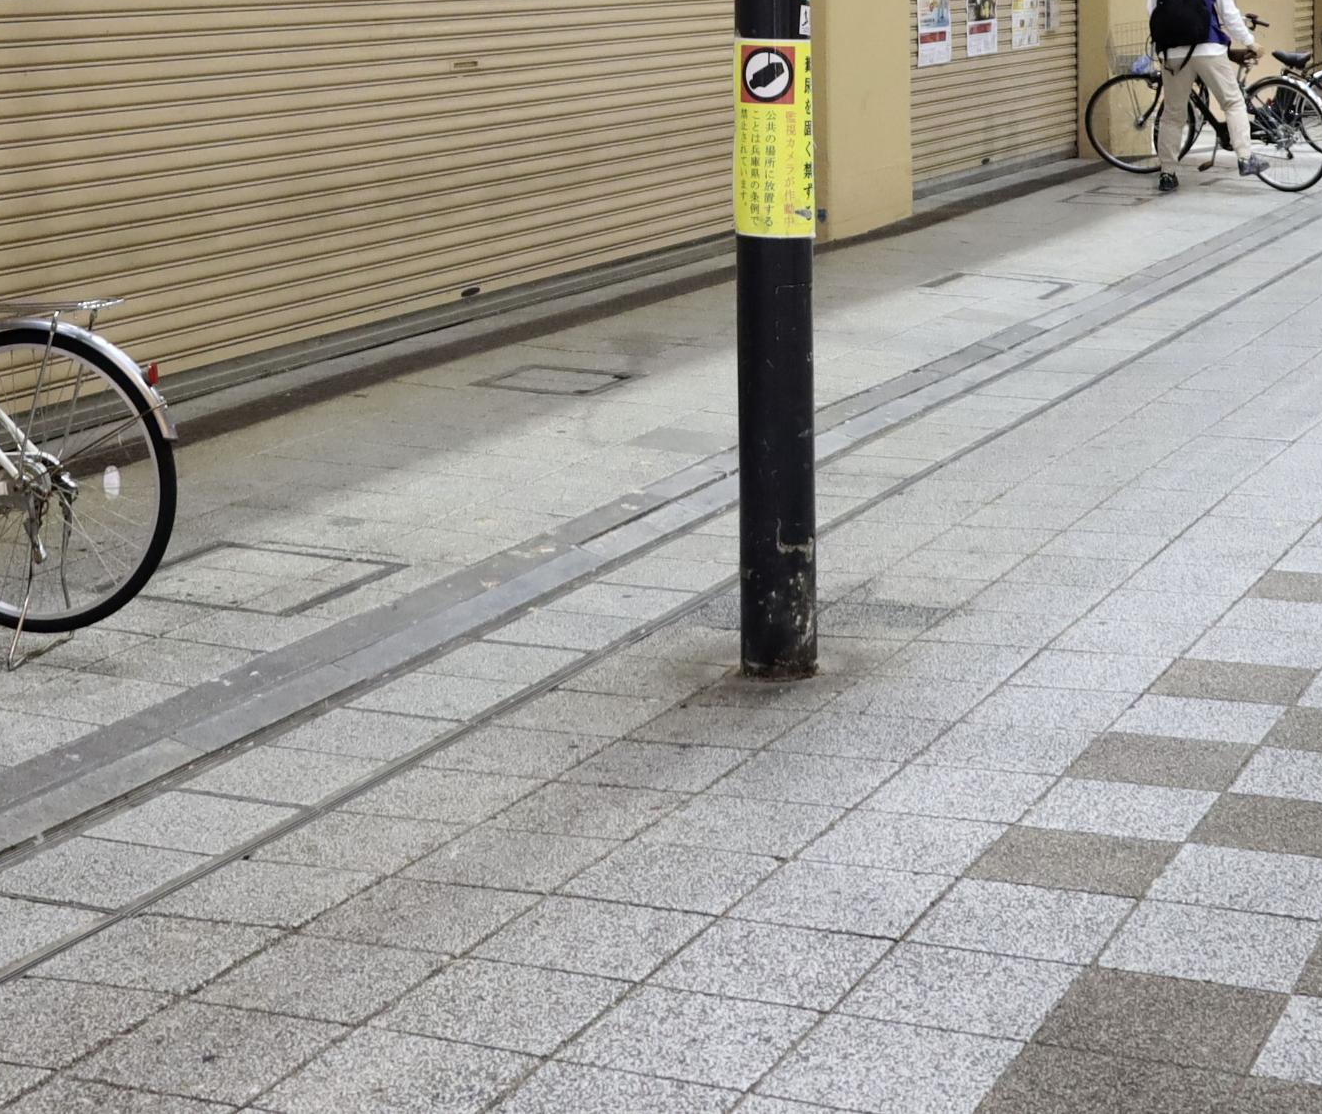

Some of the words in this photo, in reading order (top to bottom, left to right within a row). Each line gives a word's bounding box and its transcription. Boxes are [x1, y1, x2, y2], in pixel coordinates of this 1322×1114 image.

[749, 110, 761, 226] ことは兵庫県の条例で
[764, 110, 777, 227] 公共の場所に放置する
